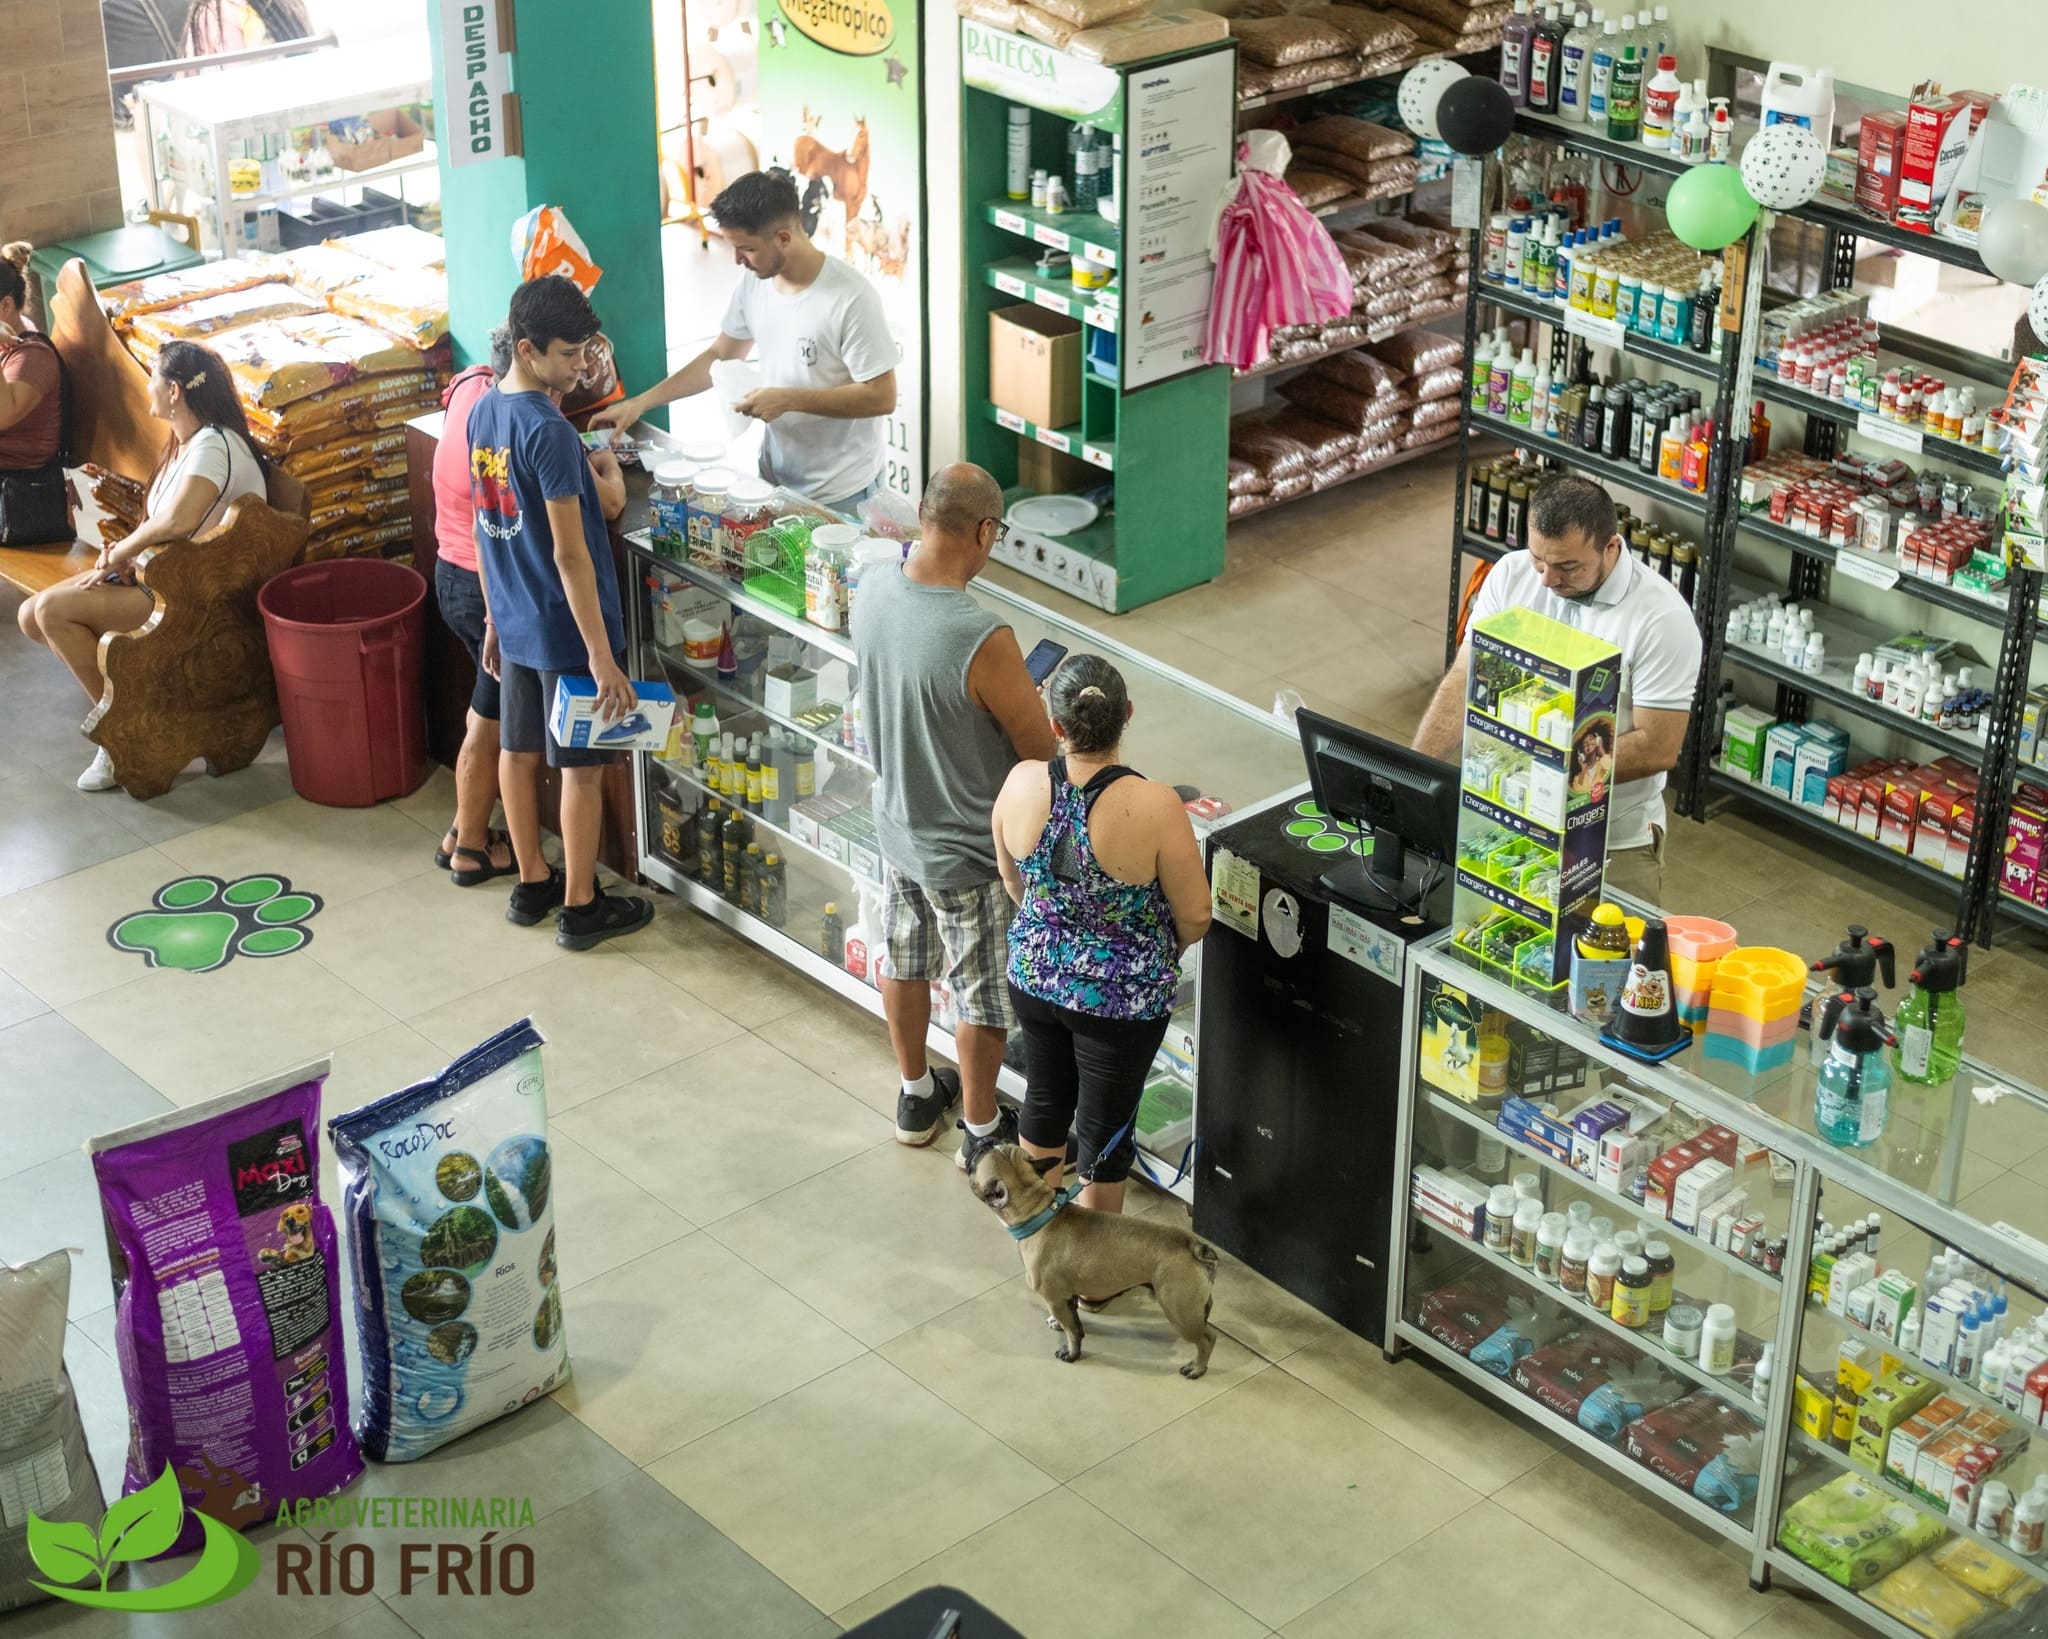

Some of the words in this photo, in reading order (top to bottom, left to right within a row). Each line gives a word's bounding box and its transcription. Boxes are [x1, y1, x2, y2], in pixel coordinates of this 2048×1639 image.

[967, 27, 1057, 82] RATECSA
[463, 4, 492, 154] DESPACHO
[371, 386, 411, 404] ADULTO
[1474, 633, 1504, 656] Chargers
[1469, 713, 1499, 735] Chargers
[1464, 794, 1495, 817] Chargers
[1566, 804, 1606, 831] Chargers
[1561, 856, 1590, 880] CABLES
[1458, 873, 1489, 895] Chargers
[1228, 891, 1245, 907] VENTA
[268, 1170, 310, 1193] Dog
[293, 1343, 323, 1366] Benefits
[1562, 1367, 1583, 1383] noba
[1649, 1455, 1695, 1487] Canada
